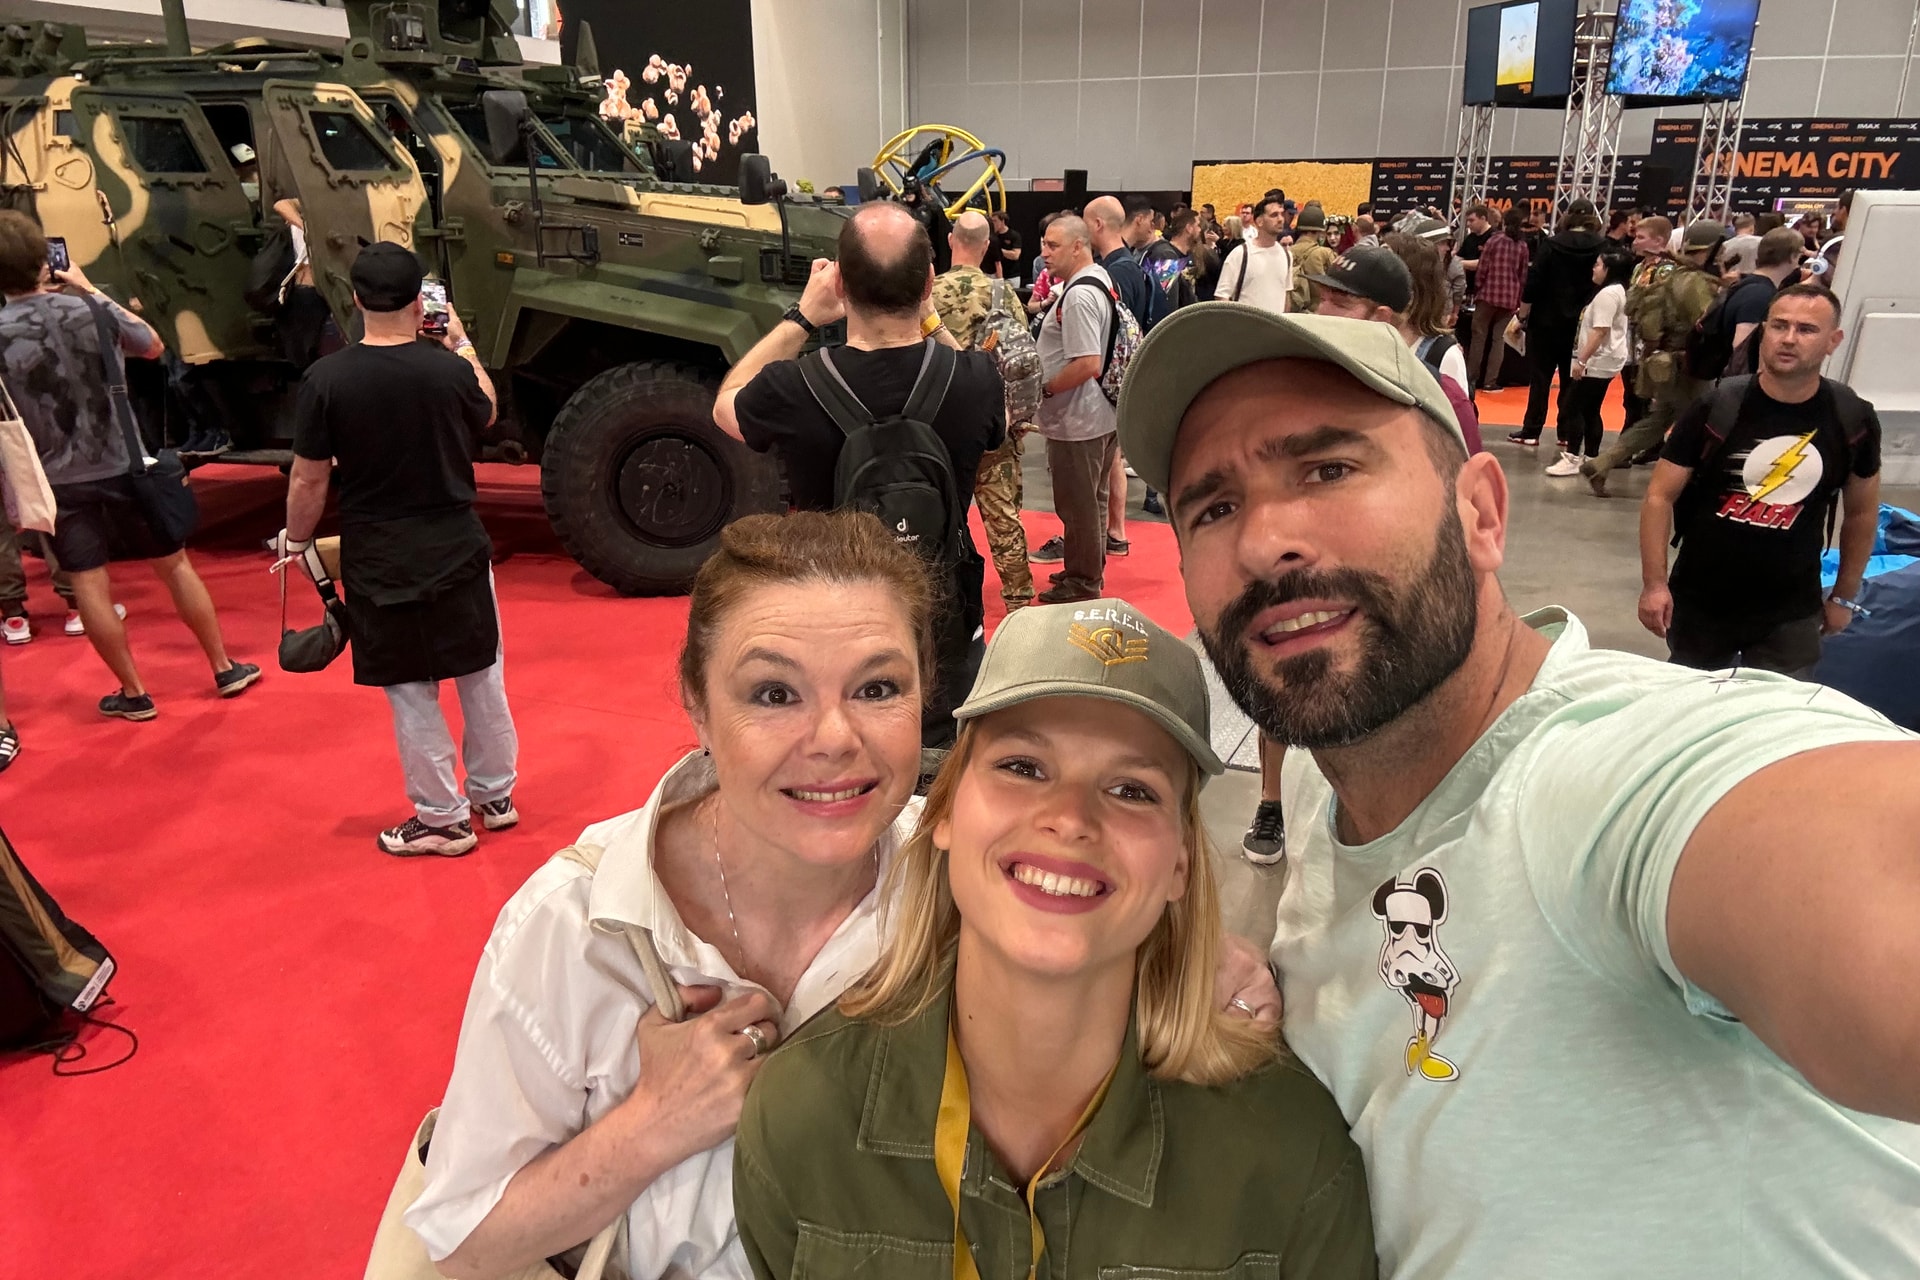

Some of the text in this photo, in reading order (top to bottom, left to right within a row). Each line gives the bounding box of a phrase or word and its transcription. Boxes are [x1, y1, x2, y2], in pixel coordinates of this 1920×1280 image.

[1704, 151, 1900, 178] CINEMA CITY
[1716, 493, 1804, 530] FLASH
